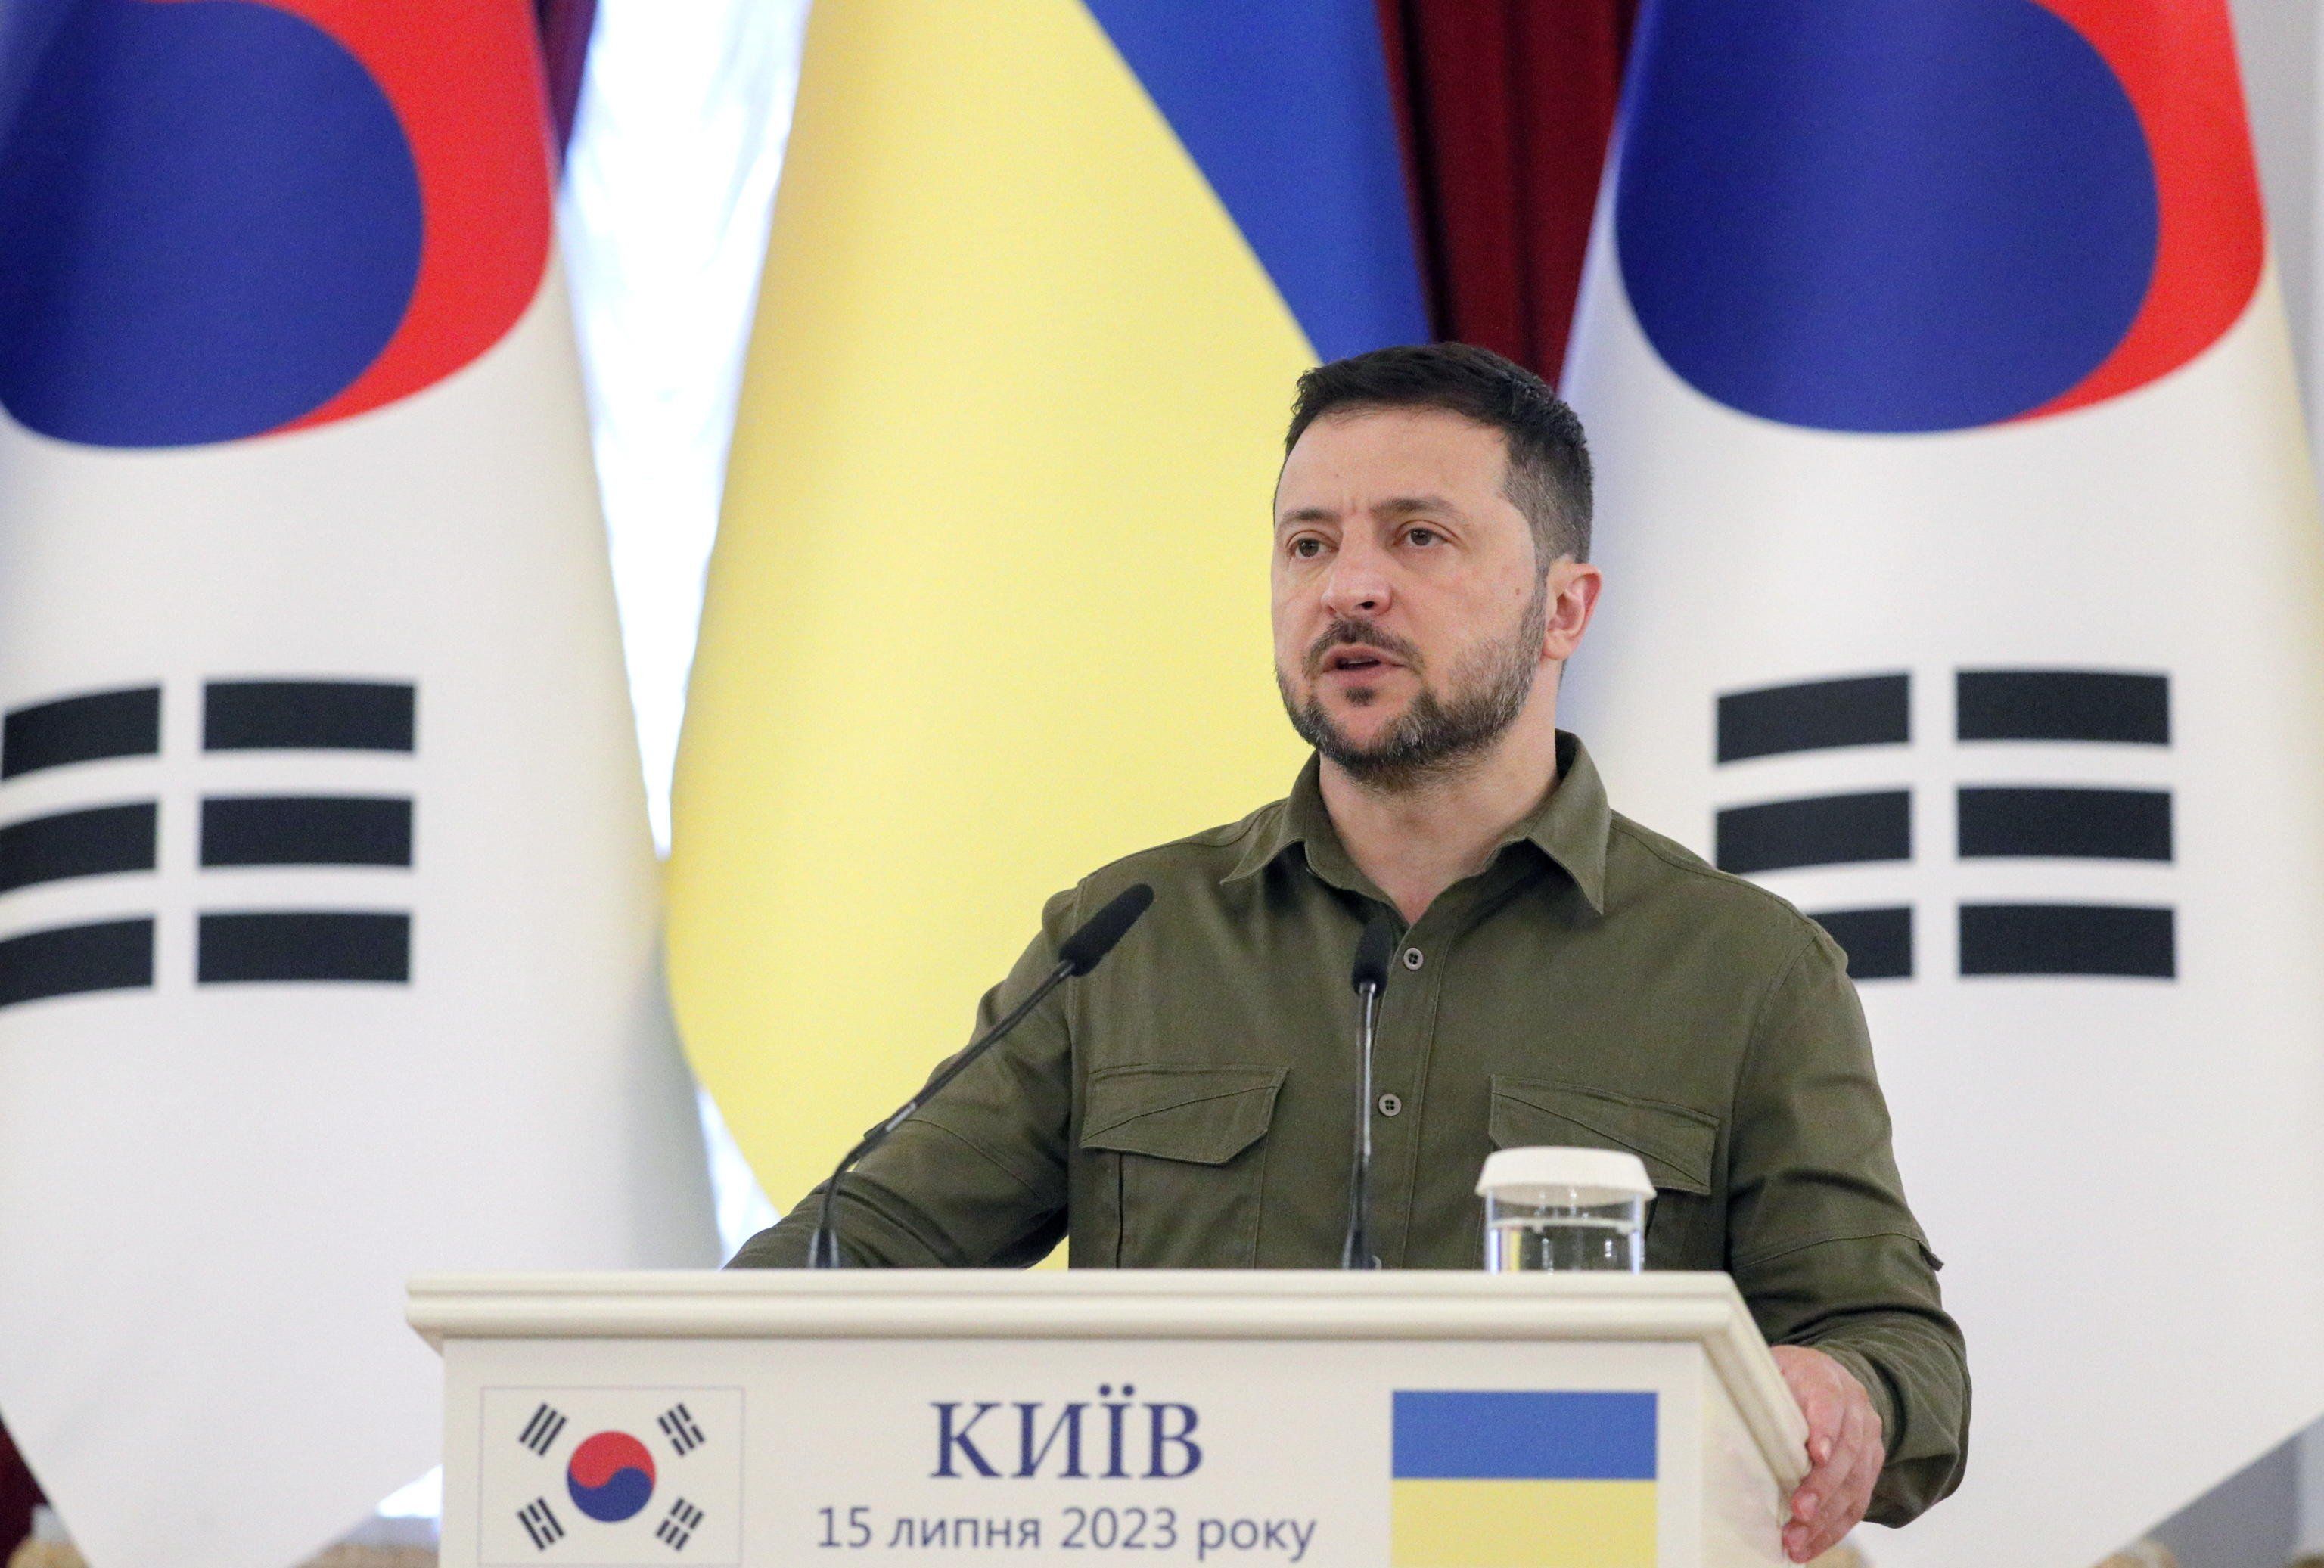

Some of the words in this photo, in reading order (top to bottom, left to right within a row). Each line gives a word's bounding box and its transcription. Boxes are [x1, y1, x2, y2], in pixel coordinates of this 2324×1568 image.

[929, 1383, 1204, 1480] КИЇВ
[817, 1506, 872, 1549] 15
[888, 1517, 1041, 1548] липня
[1061, 1506, 1178, 1549] 2023
[1197, 1518, 1317, 1563] року
